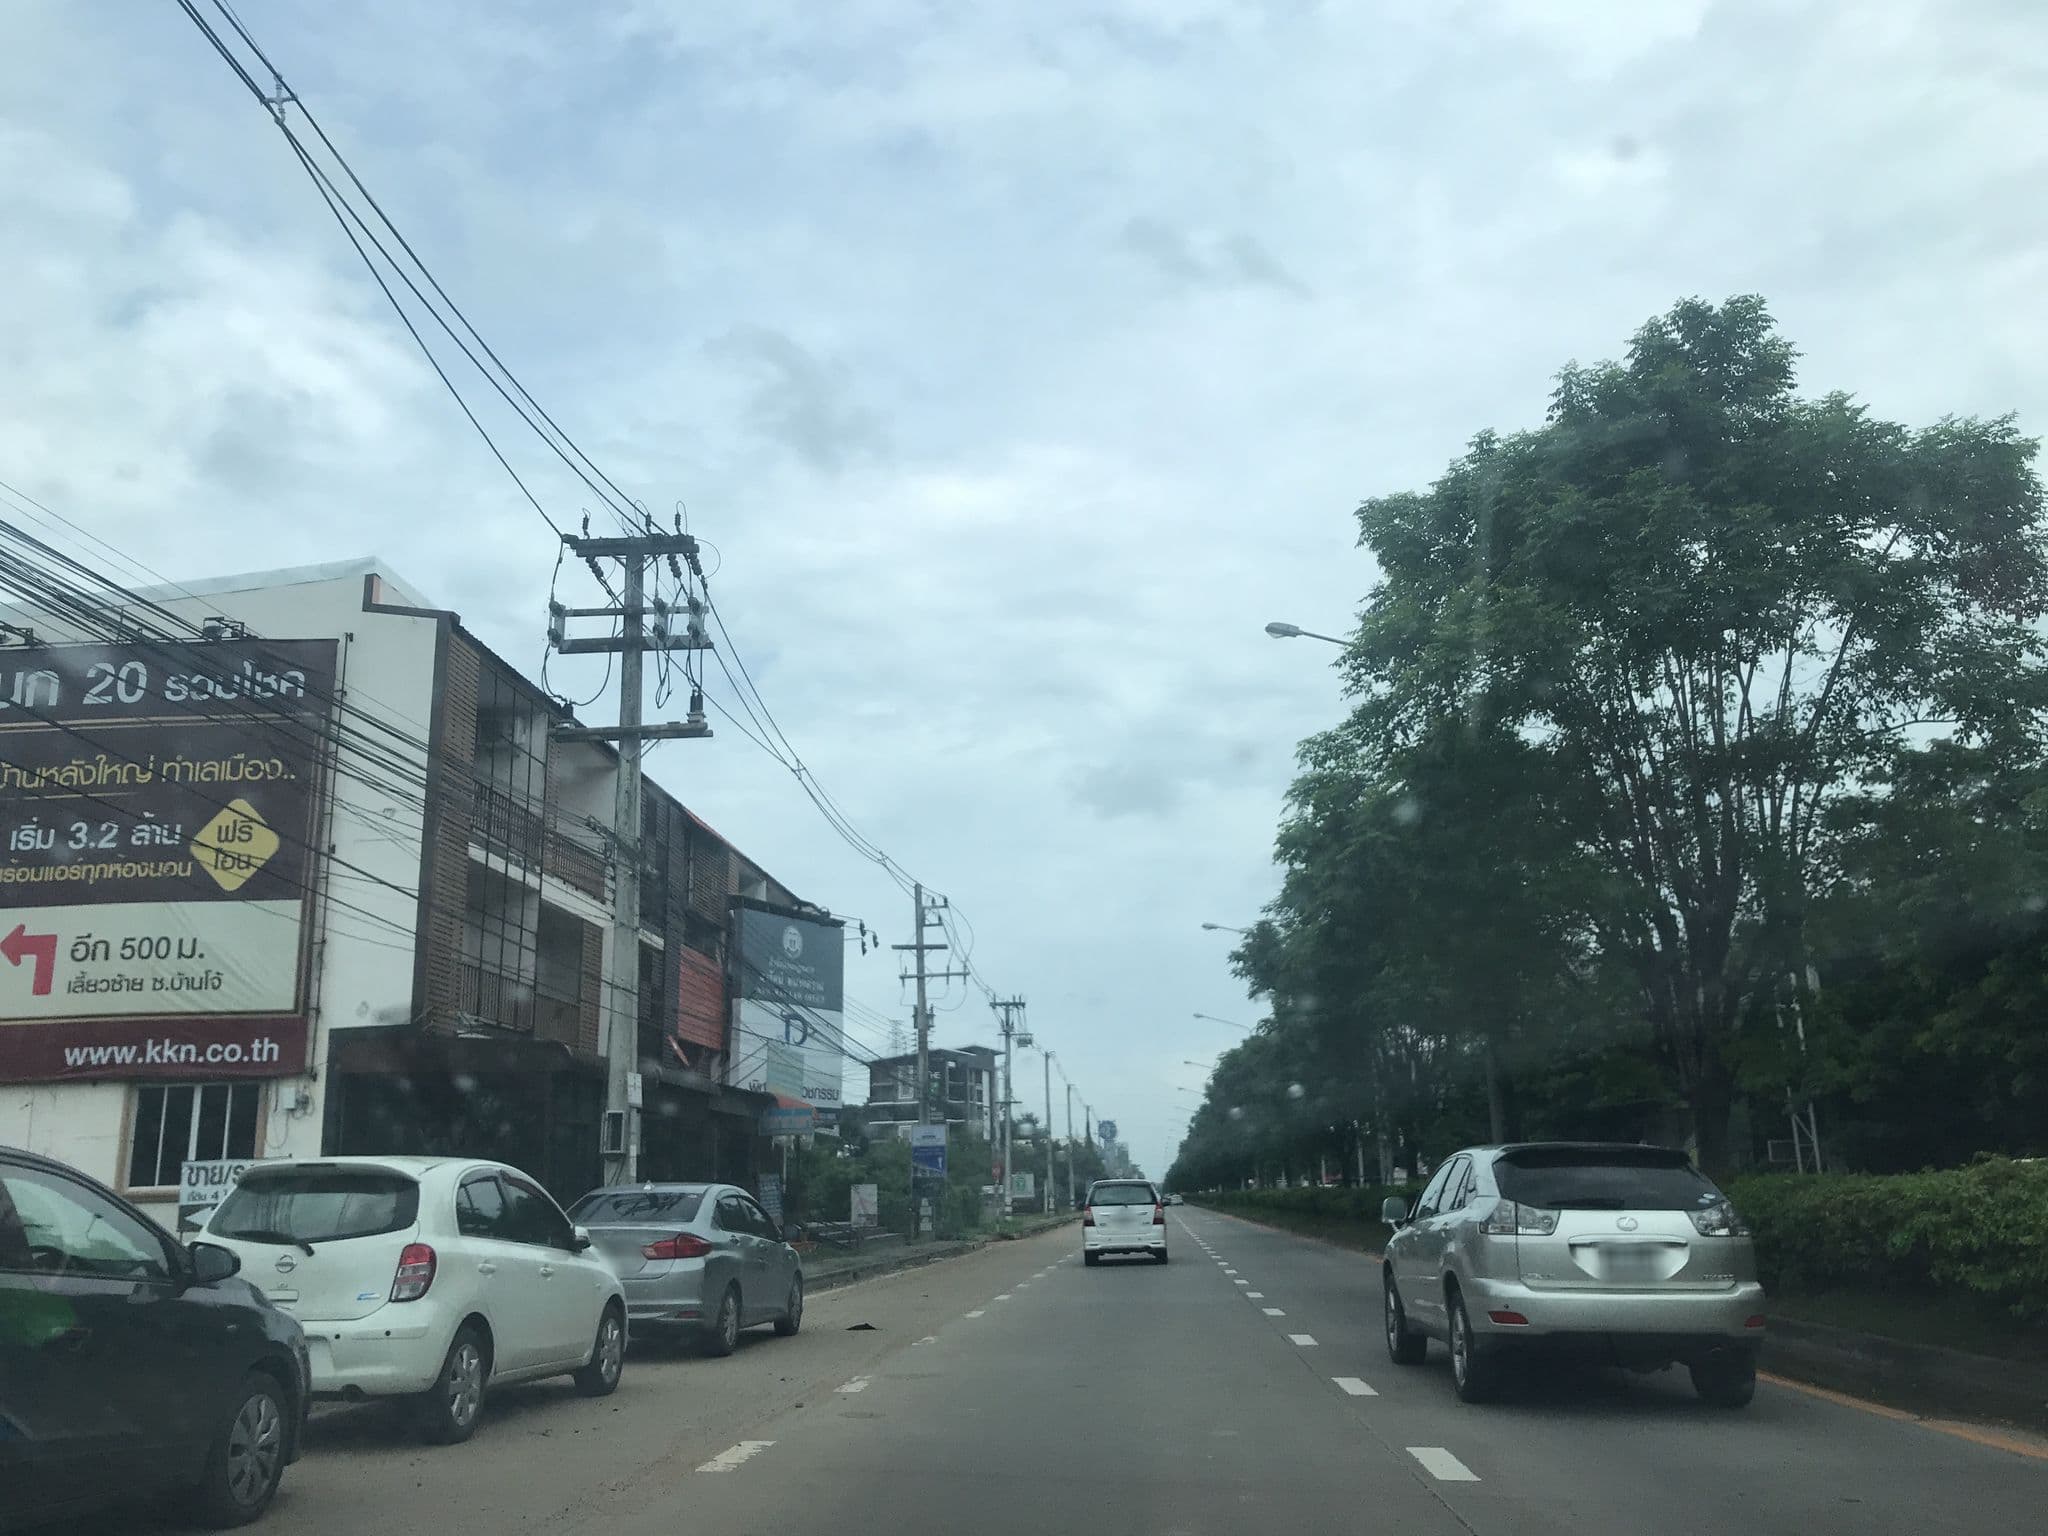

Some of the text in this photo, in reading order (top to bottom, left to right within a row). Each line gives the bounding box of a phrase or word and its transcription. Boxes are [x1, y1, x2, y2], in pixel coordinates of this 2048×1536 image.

[82, 661, 147, 704] 20
[0, 754, 155, 788] ้านหลังใหญ่
[10, 811, 182, 851] เริ่ม 3.2 ล้าน
[217, 819, 254, 843] ฟรี
[0, 852, 192, 885] ร้อมแอร์ทุกห้องนอน
[213, 847, 252, 870] โอน
[70, 933, 110, 962] อีก
[67, 971, 144, 994] เลี้ยวซ้าย
[64, 1036, 280, 1066] www.kkn.co.th
[187, 1164, 245, 1187] ขาย/ร
